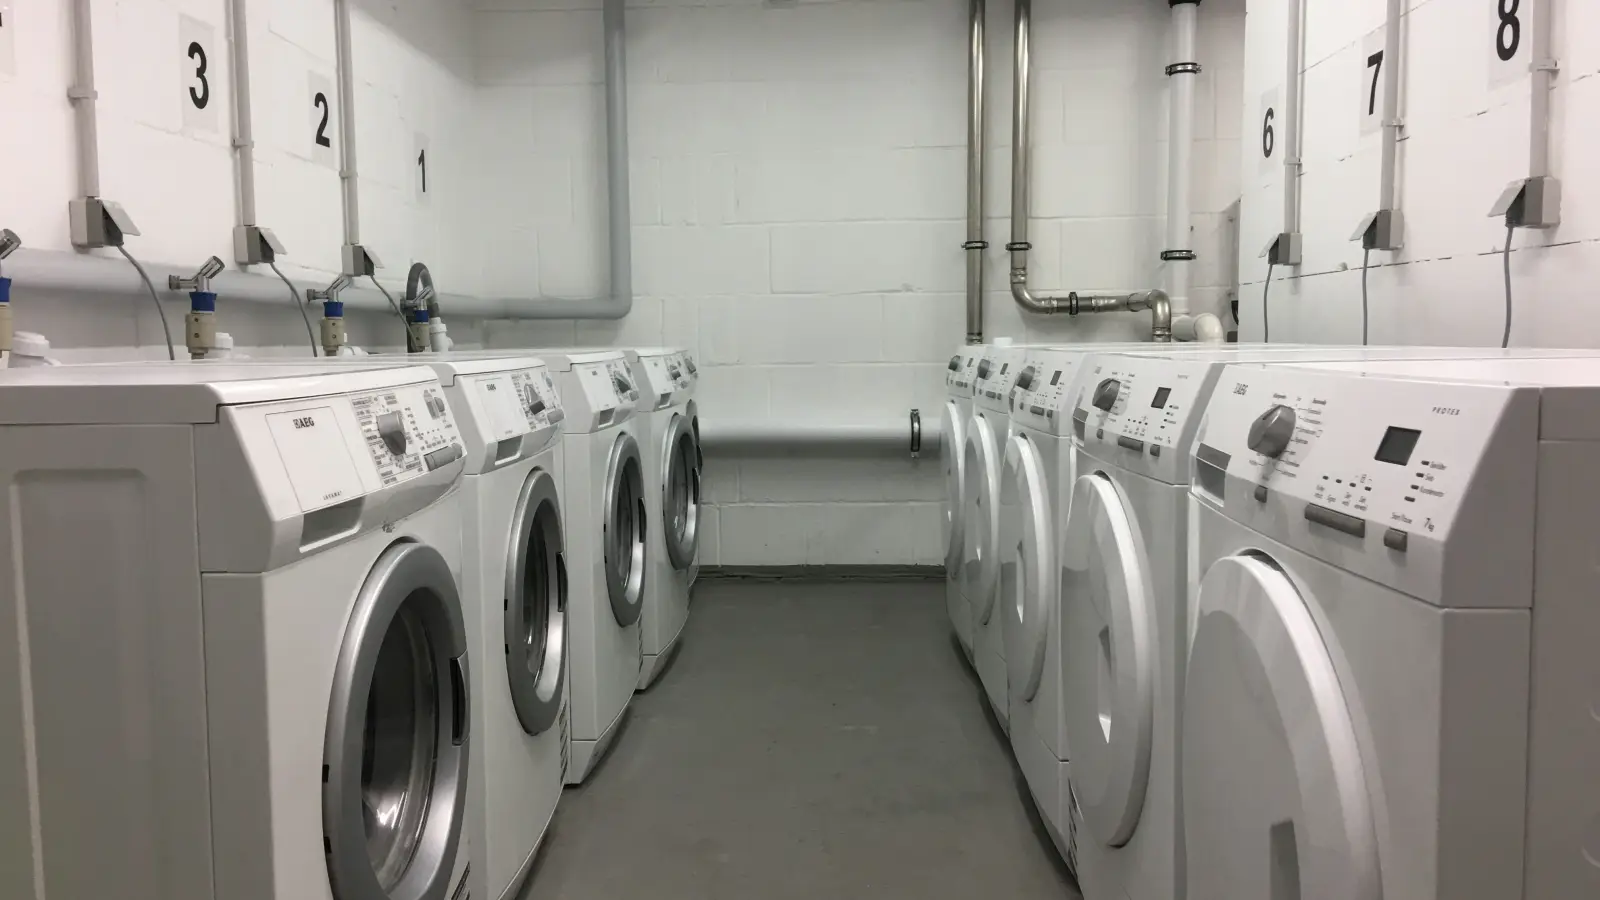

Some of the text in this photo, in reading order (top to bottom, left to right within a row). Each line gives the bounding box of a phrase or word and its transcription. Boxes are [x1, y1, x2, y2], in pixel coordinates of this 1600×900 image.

[1496, 0, 1521, 61] 8
[187, 41, 209, 110] 3
[1367, 50, 1384, 116] 7
[314, 92, 331, 148] 2
[1262, 107, 1275, 158] 6
[417, 149, 427, 193] 1
[297, 416, 315, 429] AEG
[1432, 406, 1461, 416] PROTEX
